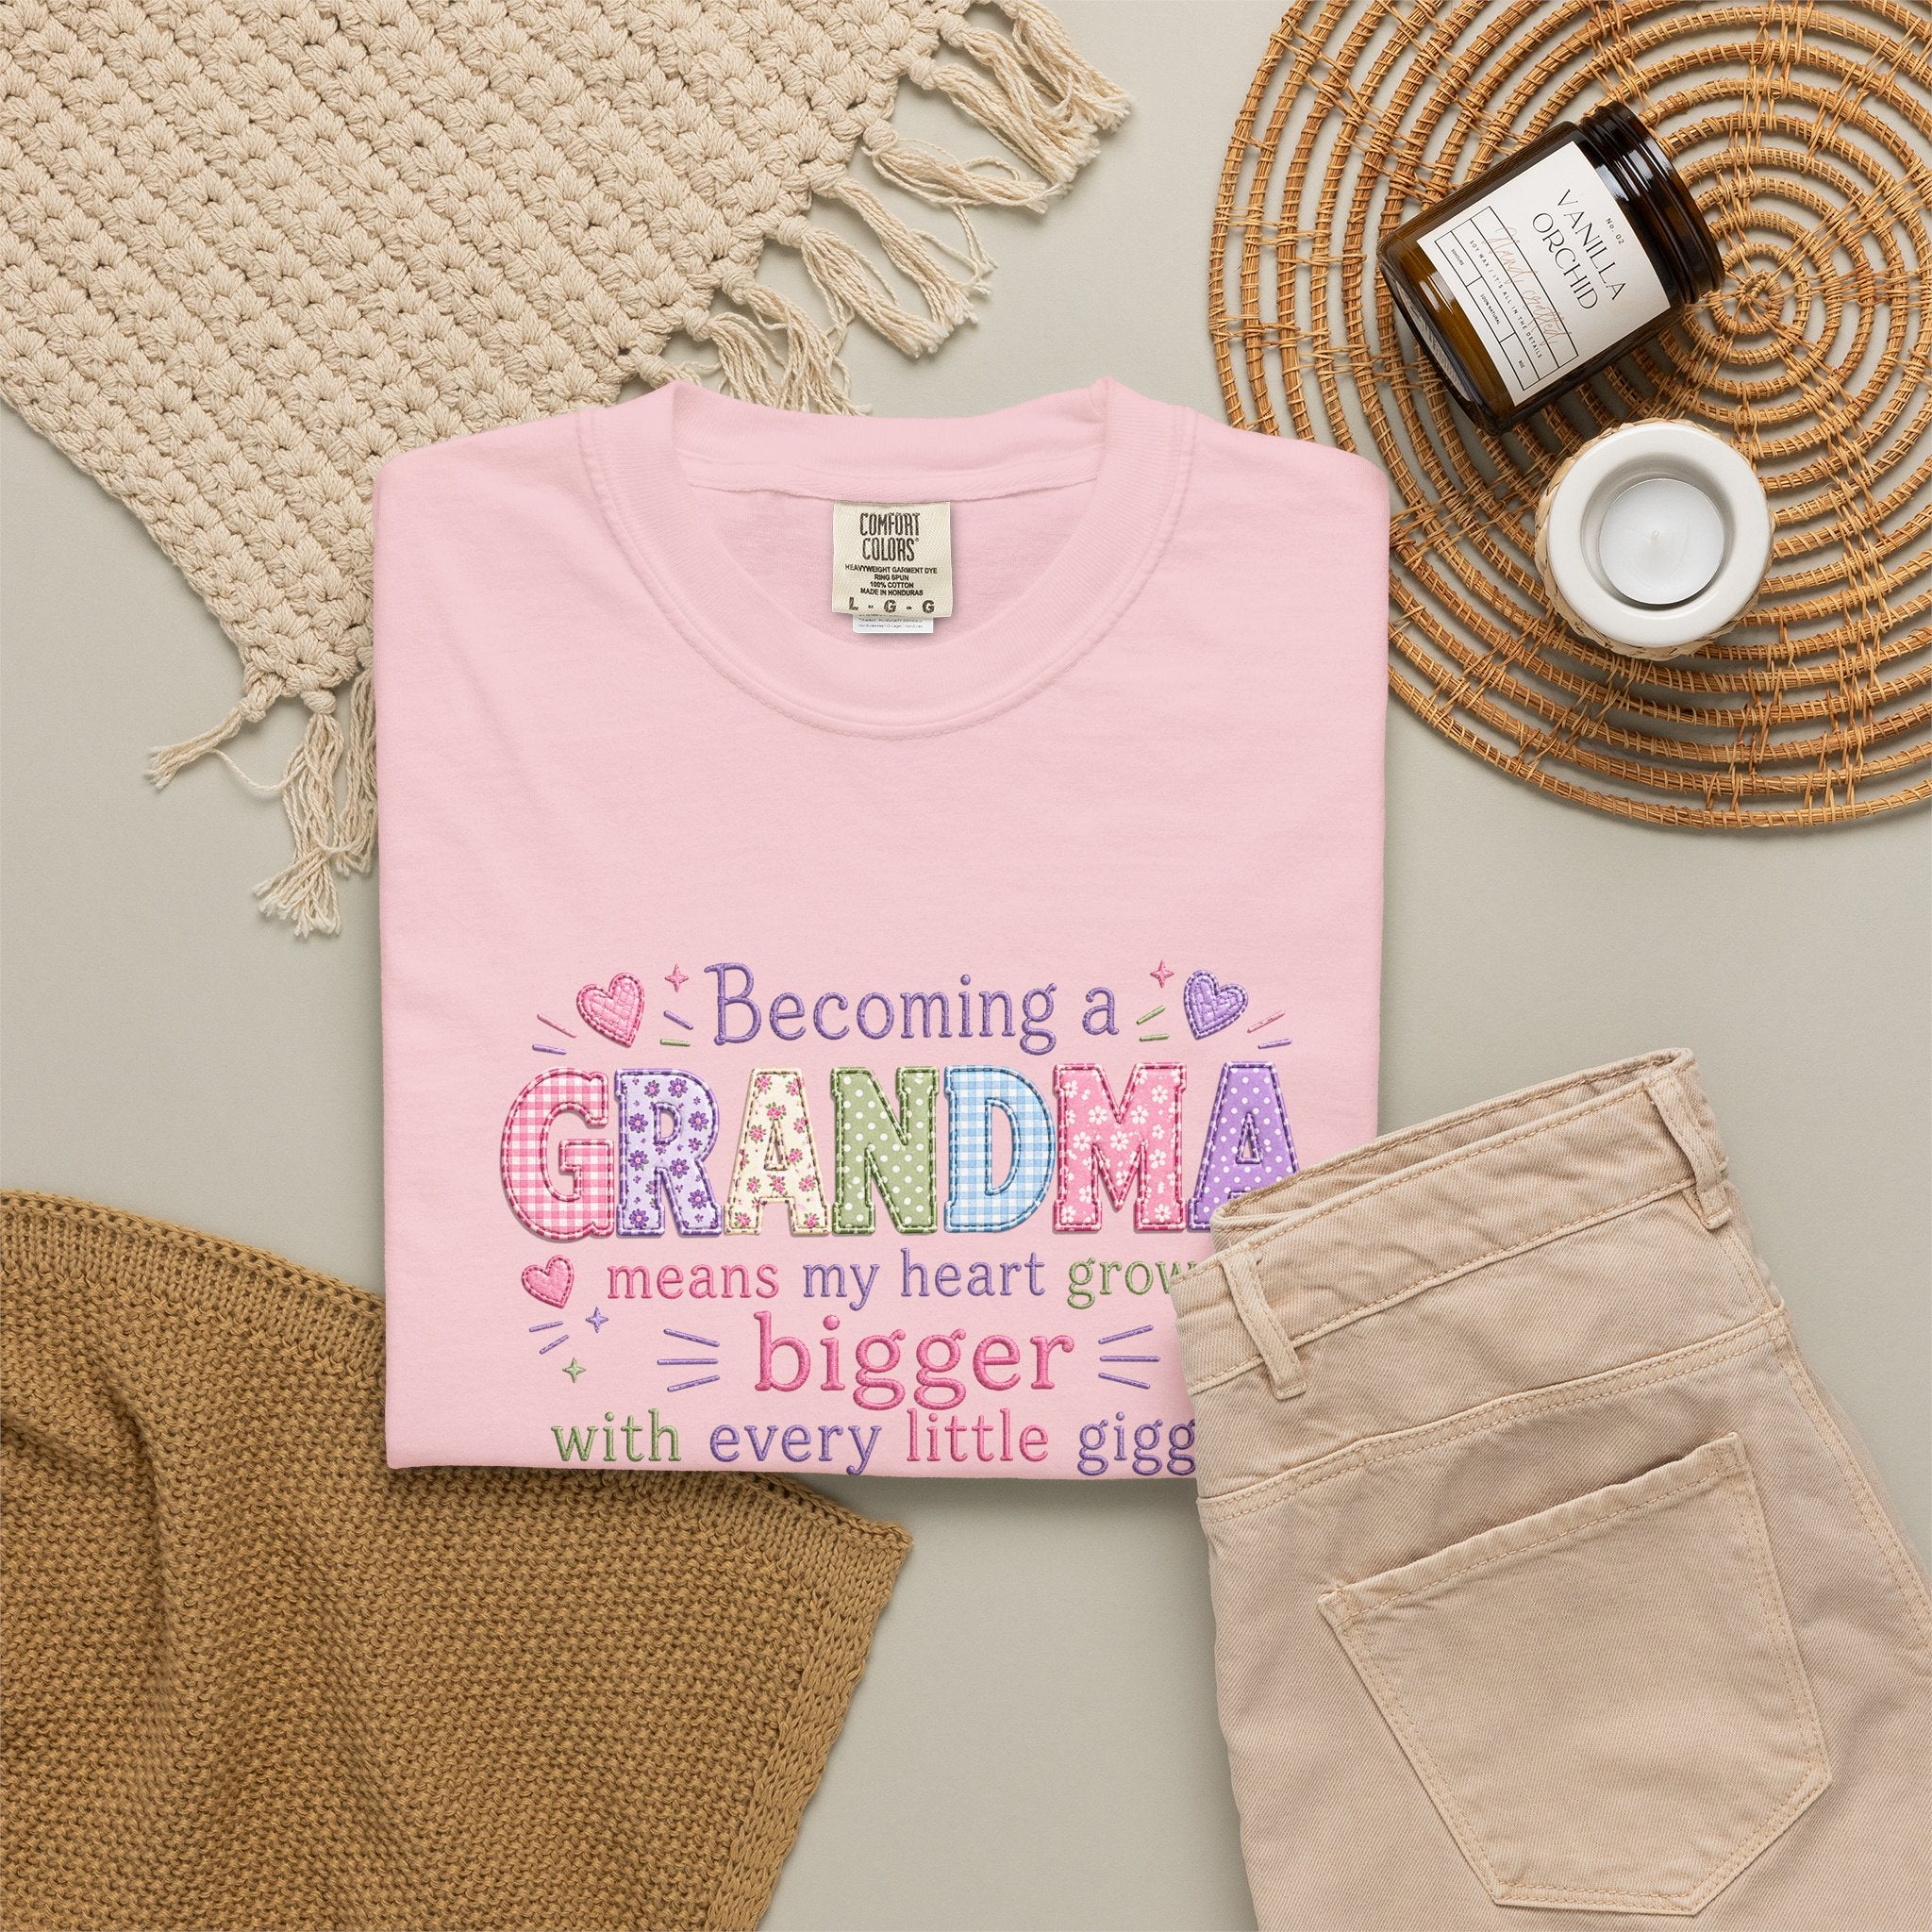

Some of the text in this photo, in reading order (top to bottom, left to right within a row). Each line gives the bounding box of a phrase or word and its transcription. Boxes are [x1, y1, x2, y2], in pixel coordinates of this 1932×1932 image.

[1532, 212, 1600, 310] ORCHID
[1557, 189, 1627, 301] VANILLA
[1606, 218, 1624, 244] No. 02
[1470, 240, 1479, 252] SOY
[1478, 253, 1490, 267] WAX
[1492, 275, 1503, 288] IT'S
[1502, 291, 1512, 304] ALL
[1511, 306, 1519, 314] IN
[1518, 316, 1528, 330] THE
[1525, 331, 1542, 358] DETAILS
[1488, 306, 1501, 325] NATURAL
[859, 512, 921, 536] COMFORT
[845, 564, 891, 574] HEAVYWEIGHT
[849, 596, 858, 610] L
[883, 600, 896, 613] G
[922, 600, 935, 613] G
[704, 963, 1121, 1056] Becoming a
[500, 1061, 1300, 1239] GRANDMA
[608, 1265, 779, 1300] means
[804, 1265, 881, 1312] my
[902, 1249, 1045, 1298] heart
[755, 1308, 1075, 1411] bigger
[552, 1409, 680, 1463] with
[708, 1425, 882, 1476] every
[908, 1407, 1049, 1463] little
